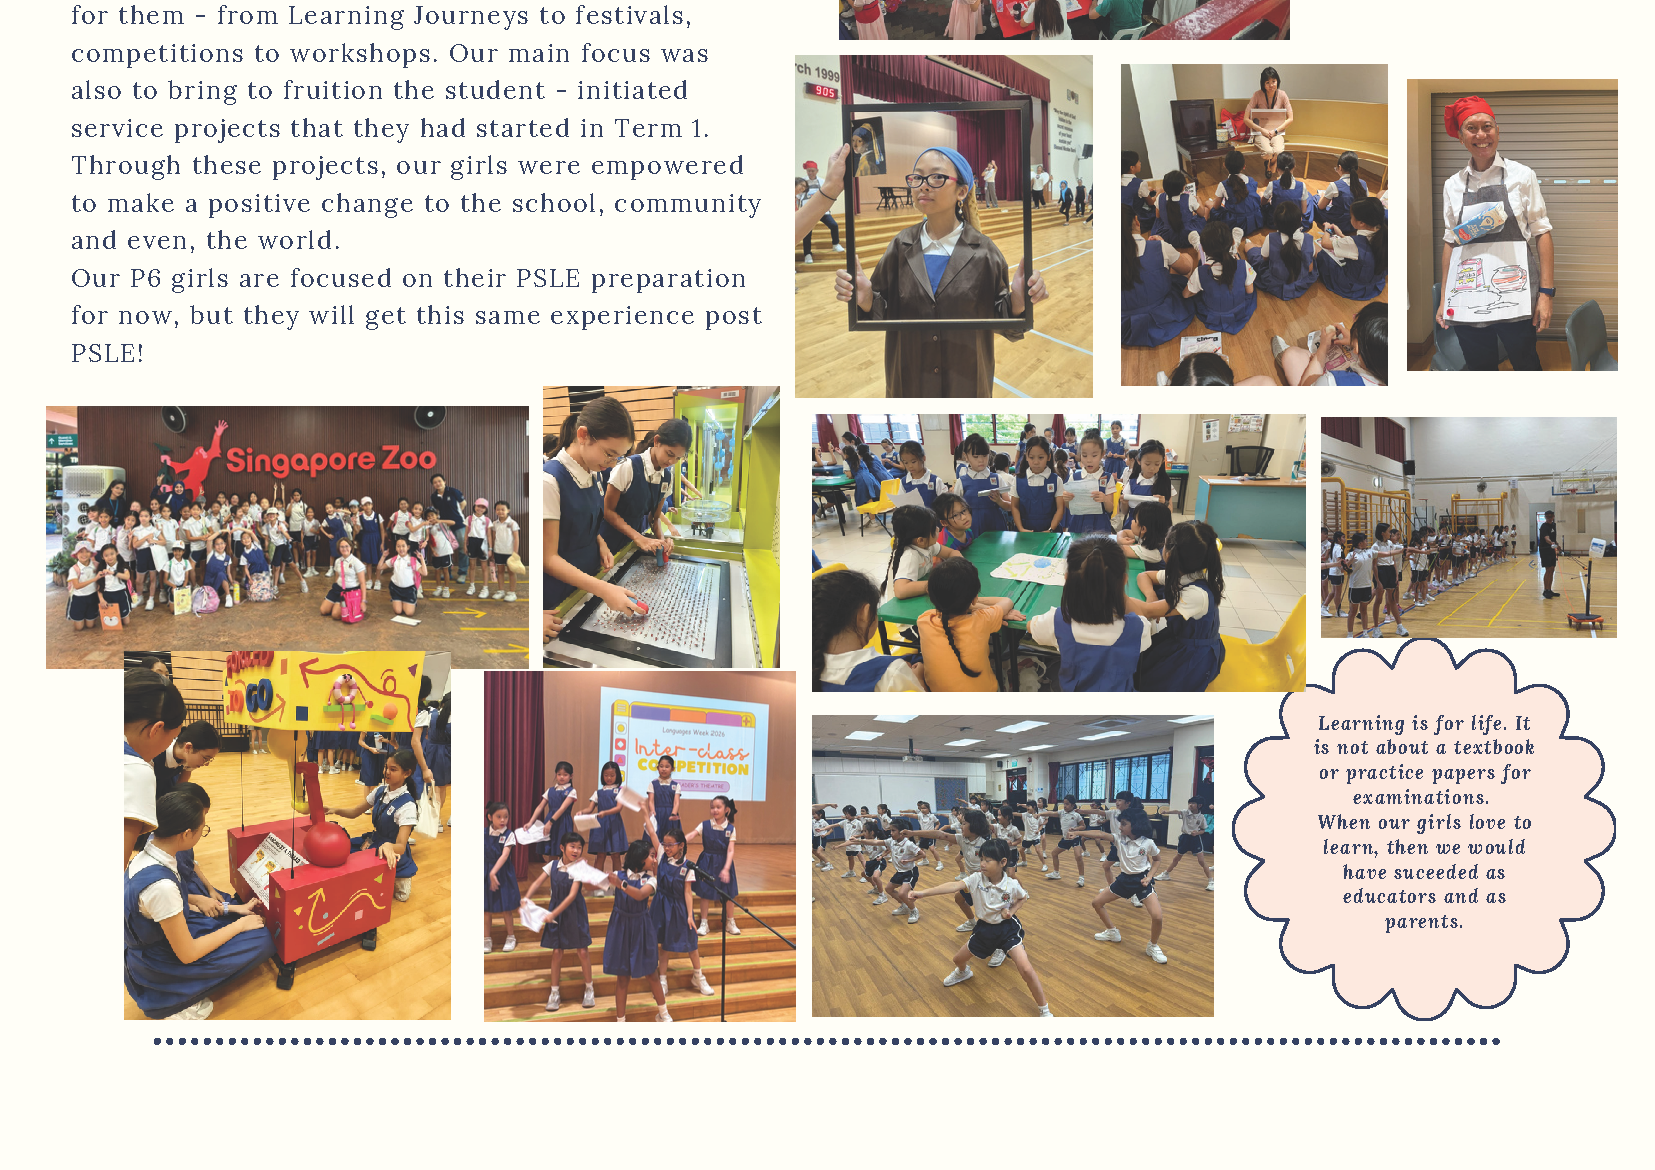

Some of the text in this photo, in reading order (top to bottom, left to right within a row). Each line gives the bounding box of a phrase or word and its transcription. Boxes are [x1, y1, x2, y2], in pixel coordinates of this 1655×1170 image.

[795, 63, 840, 83] ch 1999
[816, 85, 835, 98] 905
[226, 445, 437, 479] Singapore Zoo
[246, 678, 273, 712] GO
[693, 729, 709, 737] Week
[710, 730, 725, 738] 2026
[638, 758, 749, 775] COPETITION
